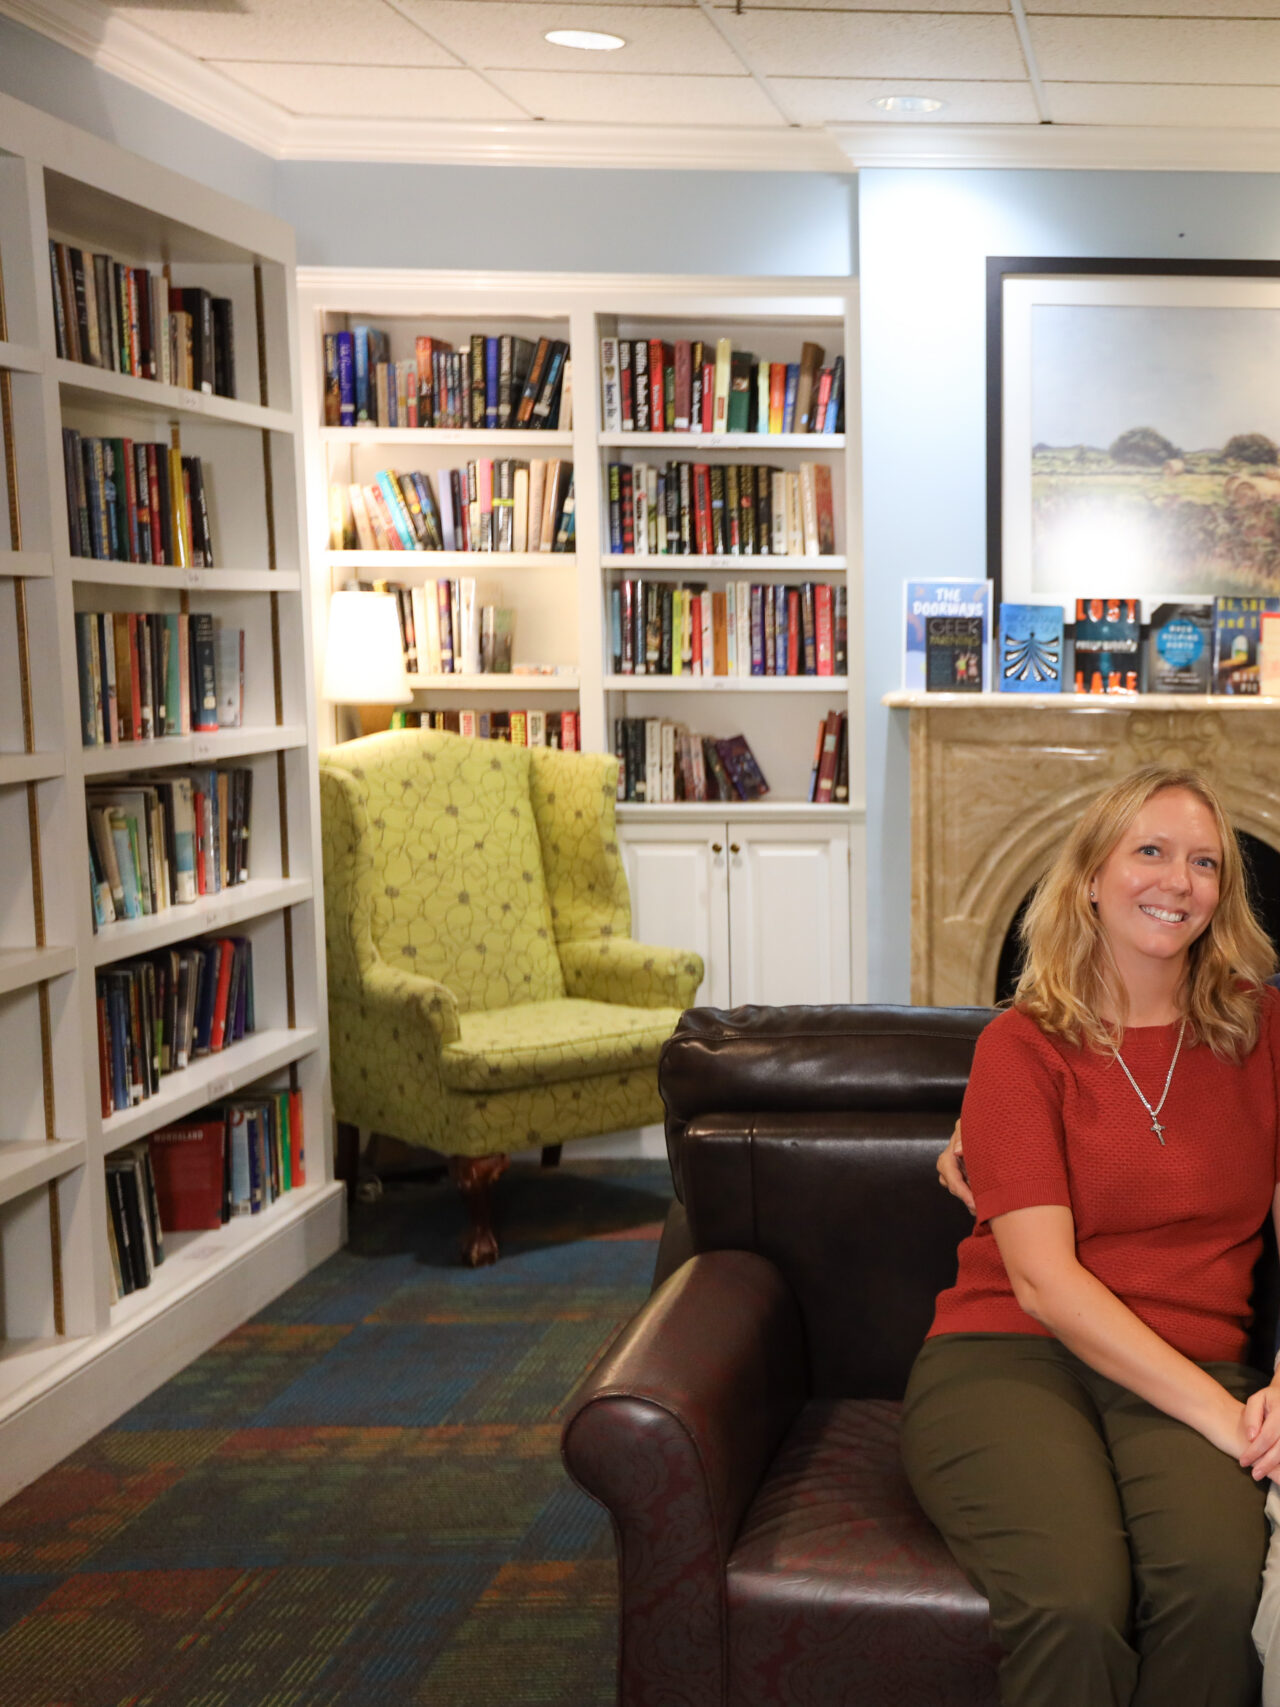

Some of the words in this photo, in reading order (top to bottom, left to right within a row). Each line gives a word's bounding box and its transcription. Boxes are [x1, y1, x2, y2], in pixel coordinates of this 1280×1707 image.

[936, 587, 961, 601] THE
[913, 601, 984, 617] DOORWAYS
[1076, 599, 1137, 624] LOST
[929, 619, 980, 636] GEEK
[1075, 671, 1138, 694] LAKE
